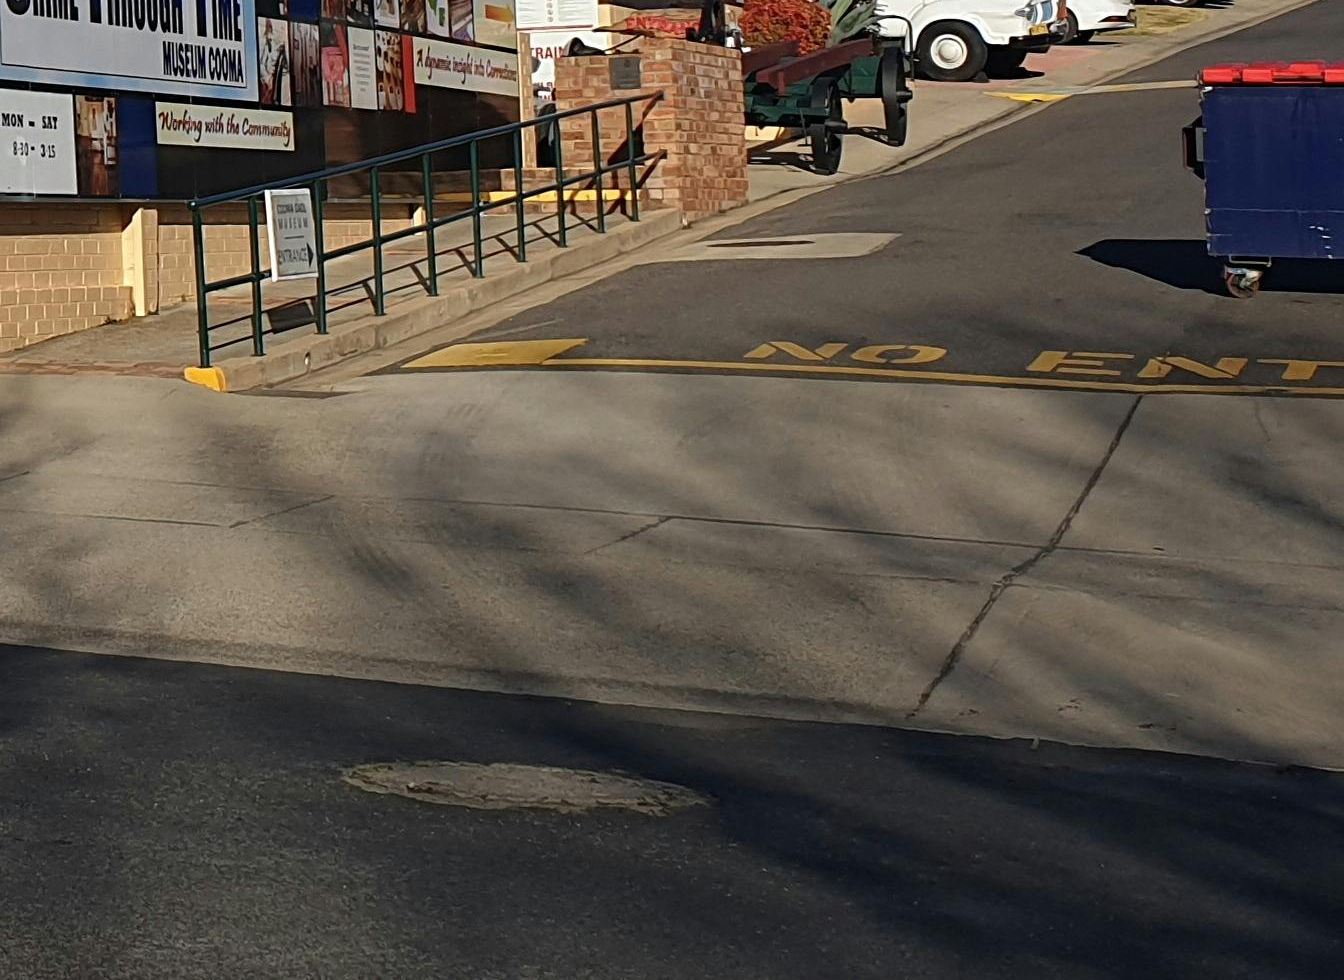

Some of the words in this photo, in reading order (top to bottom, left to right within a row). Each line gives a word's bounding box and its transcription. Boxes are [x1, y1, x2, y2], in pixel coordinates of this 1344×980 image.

[163, 41, 206, 79] MUSEUM
[209, 47, 244, 83] COOMA
[453, 52, 472, 85] insight
[1, 113, 24, 128] MON
[42, 116, 58, 130] SAT
[159, 110, 202, 142] Working
[205, 113, 224, 136] with
[226, 115, 239, 135] the
[242, 118, 291, 147] Community
[278, 248, 308, 265] ENTRANCE
[743, 341, 948, 364] NO
[1025, 350, 1344, 382] ENT
